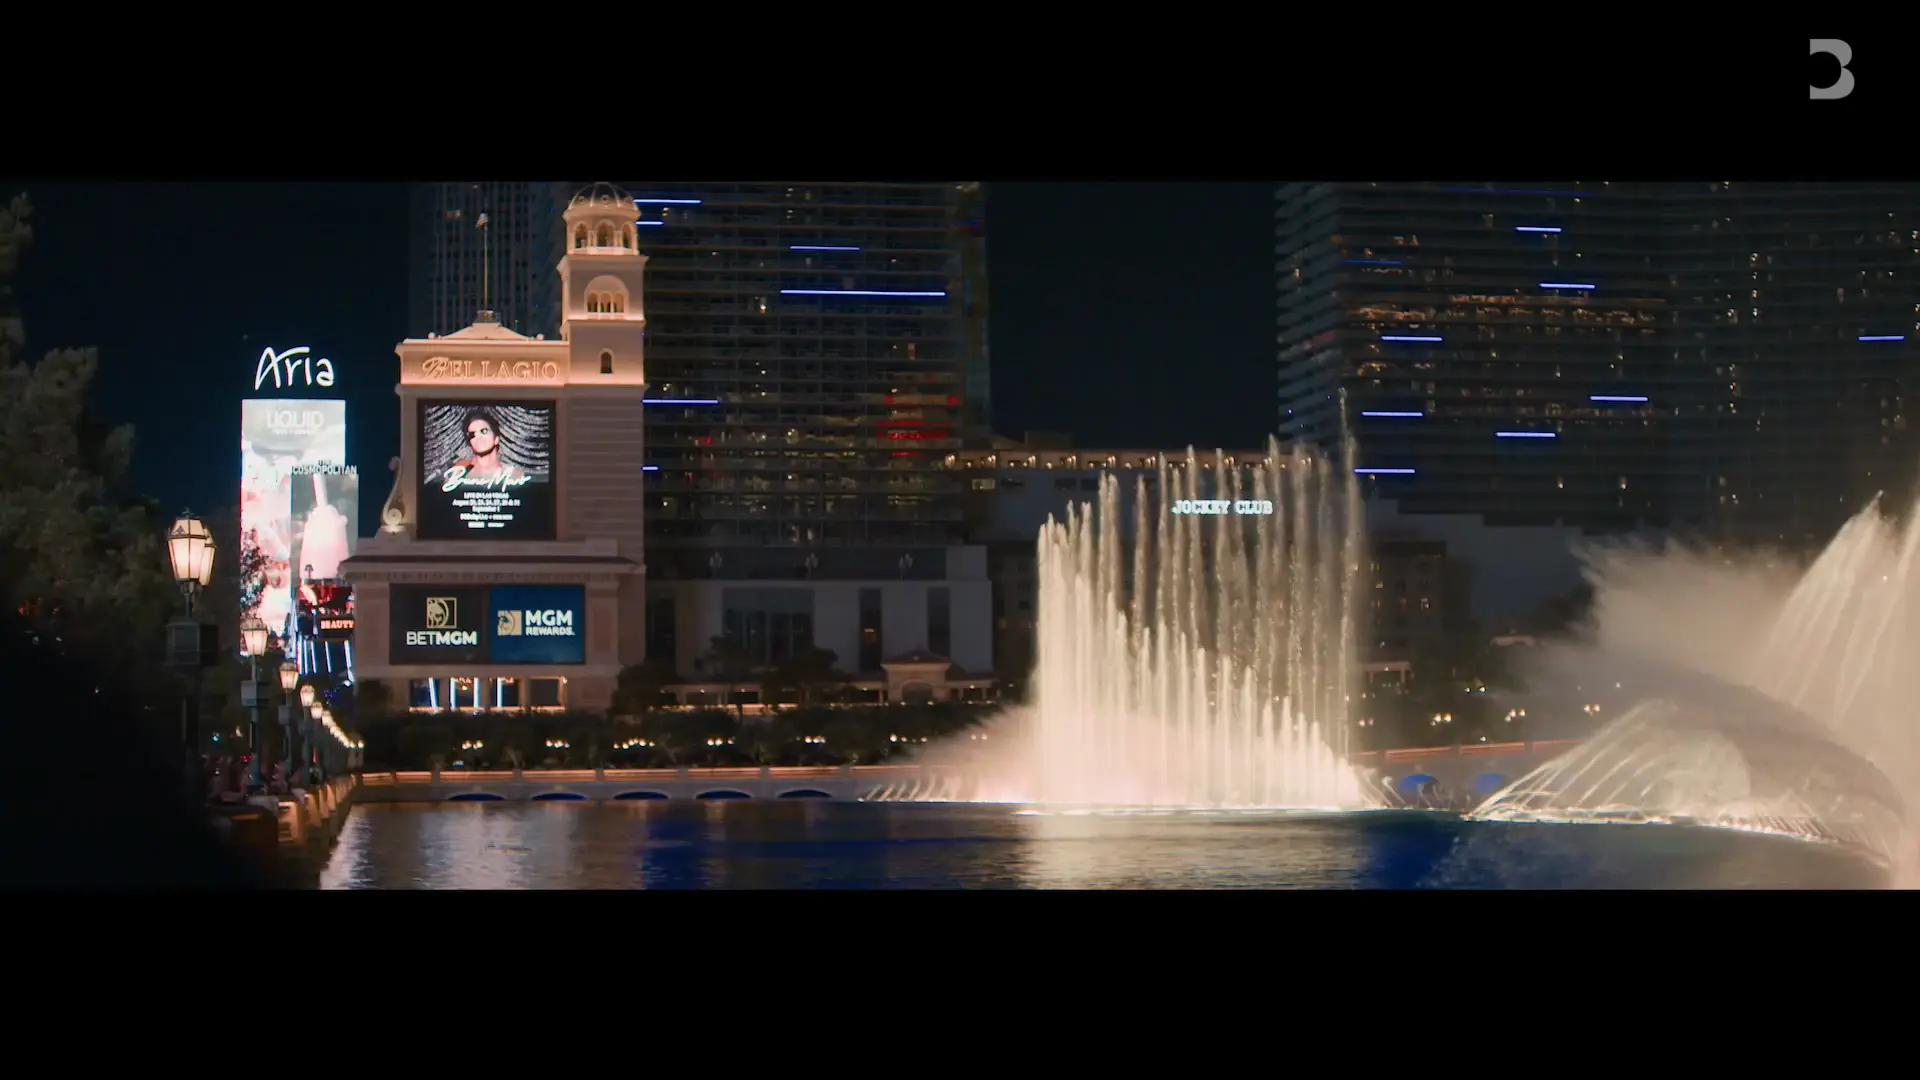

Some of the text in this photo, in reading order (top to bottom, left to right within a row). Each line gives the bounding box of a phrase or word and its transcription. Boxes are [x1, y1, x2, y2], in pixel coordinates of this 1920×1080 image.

[254, 346, 335, 391] Aria
[422, 356, 560, 380] BELLAGIO
[292, 465, 358, 476] COSMOPOLITAN
[1171, 500, 1273, 514] JOCKEY CLUB
[320, 619, 355, 630] BEAUTY
[525, 609, 573, 626] MGM
[406, 631, 477, 646] BETMGM
